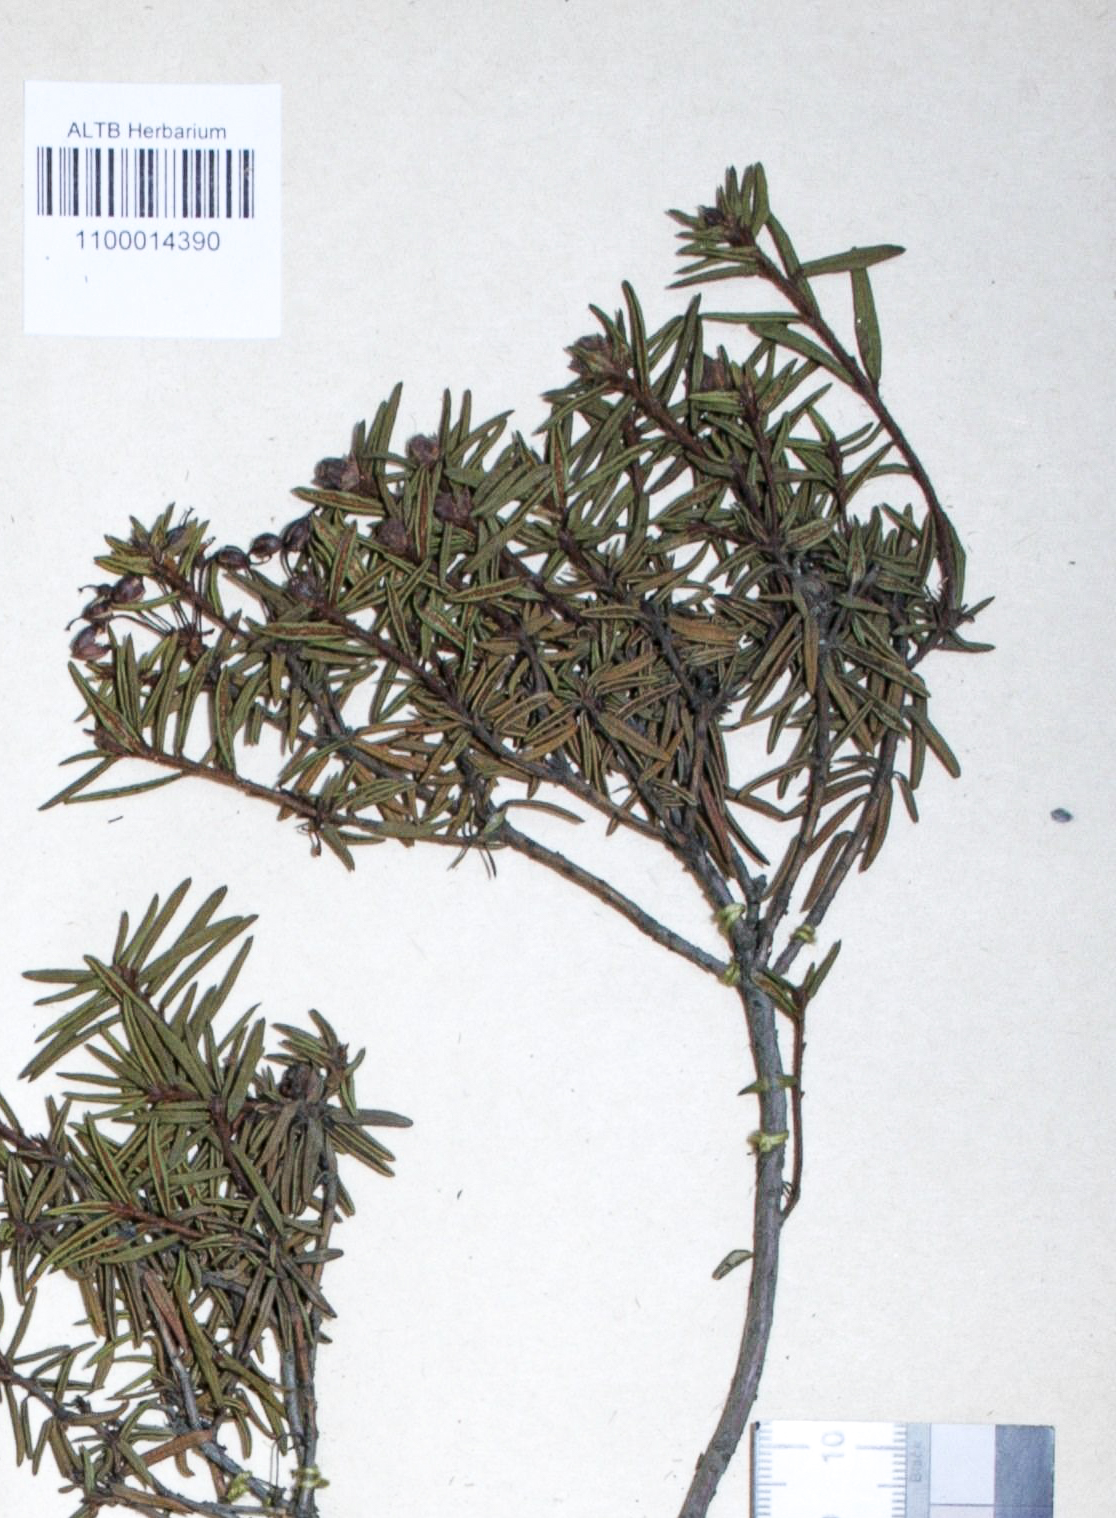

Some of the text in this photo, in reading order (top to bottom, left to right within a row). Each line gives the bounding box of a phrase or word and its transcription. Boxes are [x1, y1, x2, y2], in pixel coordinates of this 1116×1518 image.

[67, 121, 228, 140] ALTB Herbarium
[75, 229, 222, 252] 1100014390
